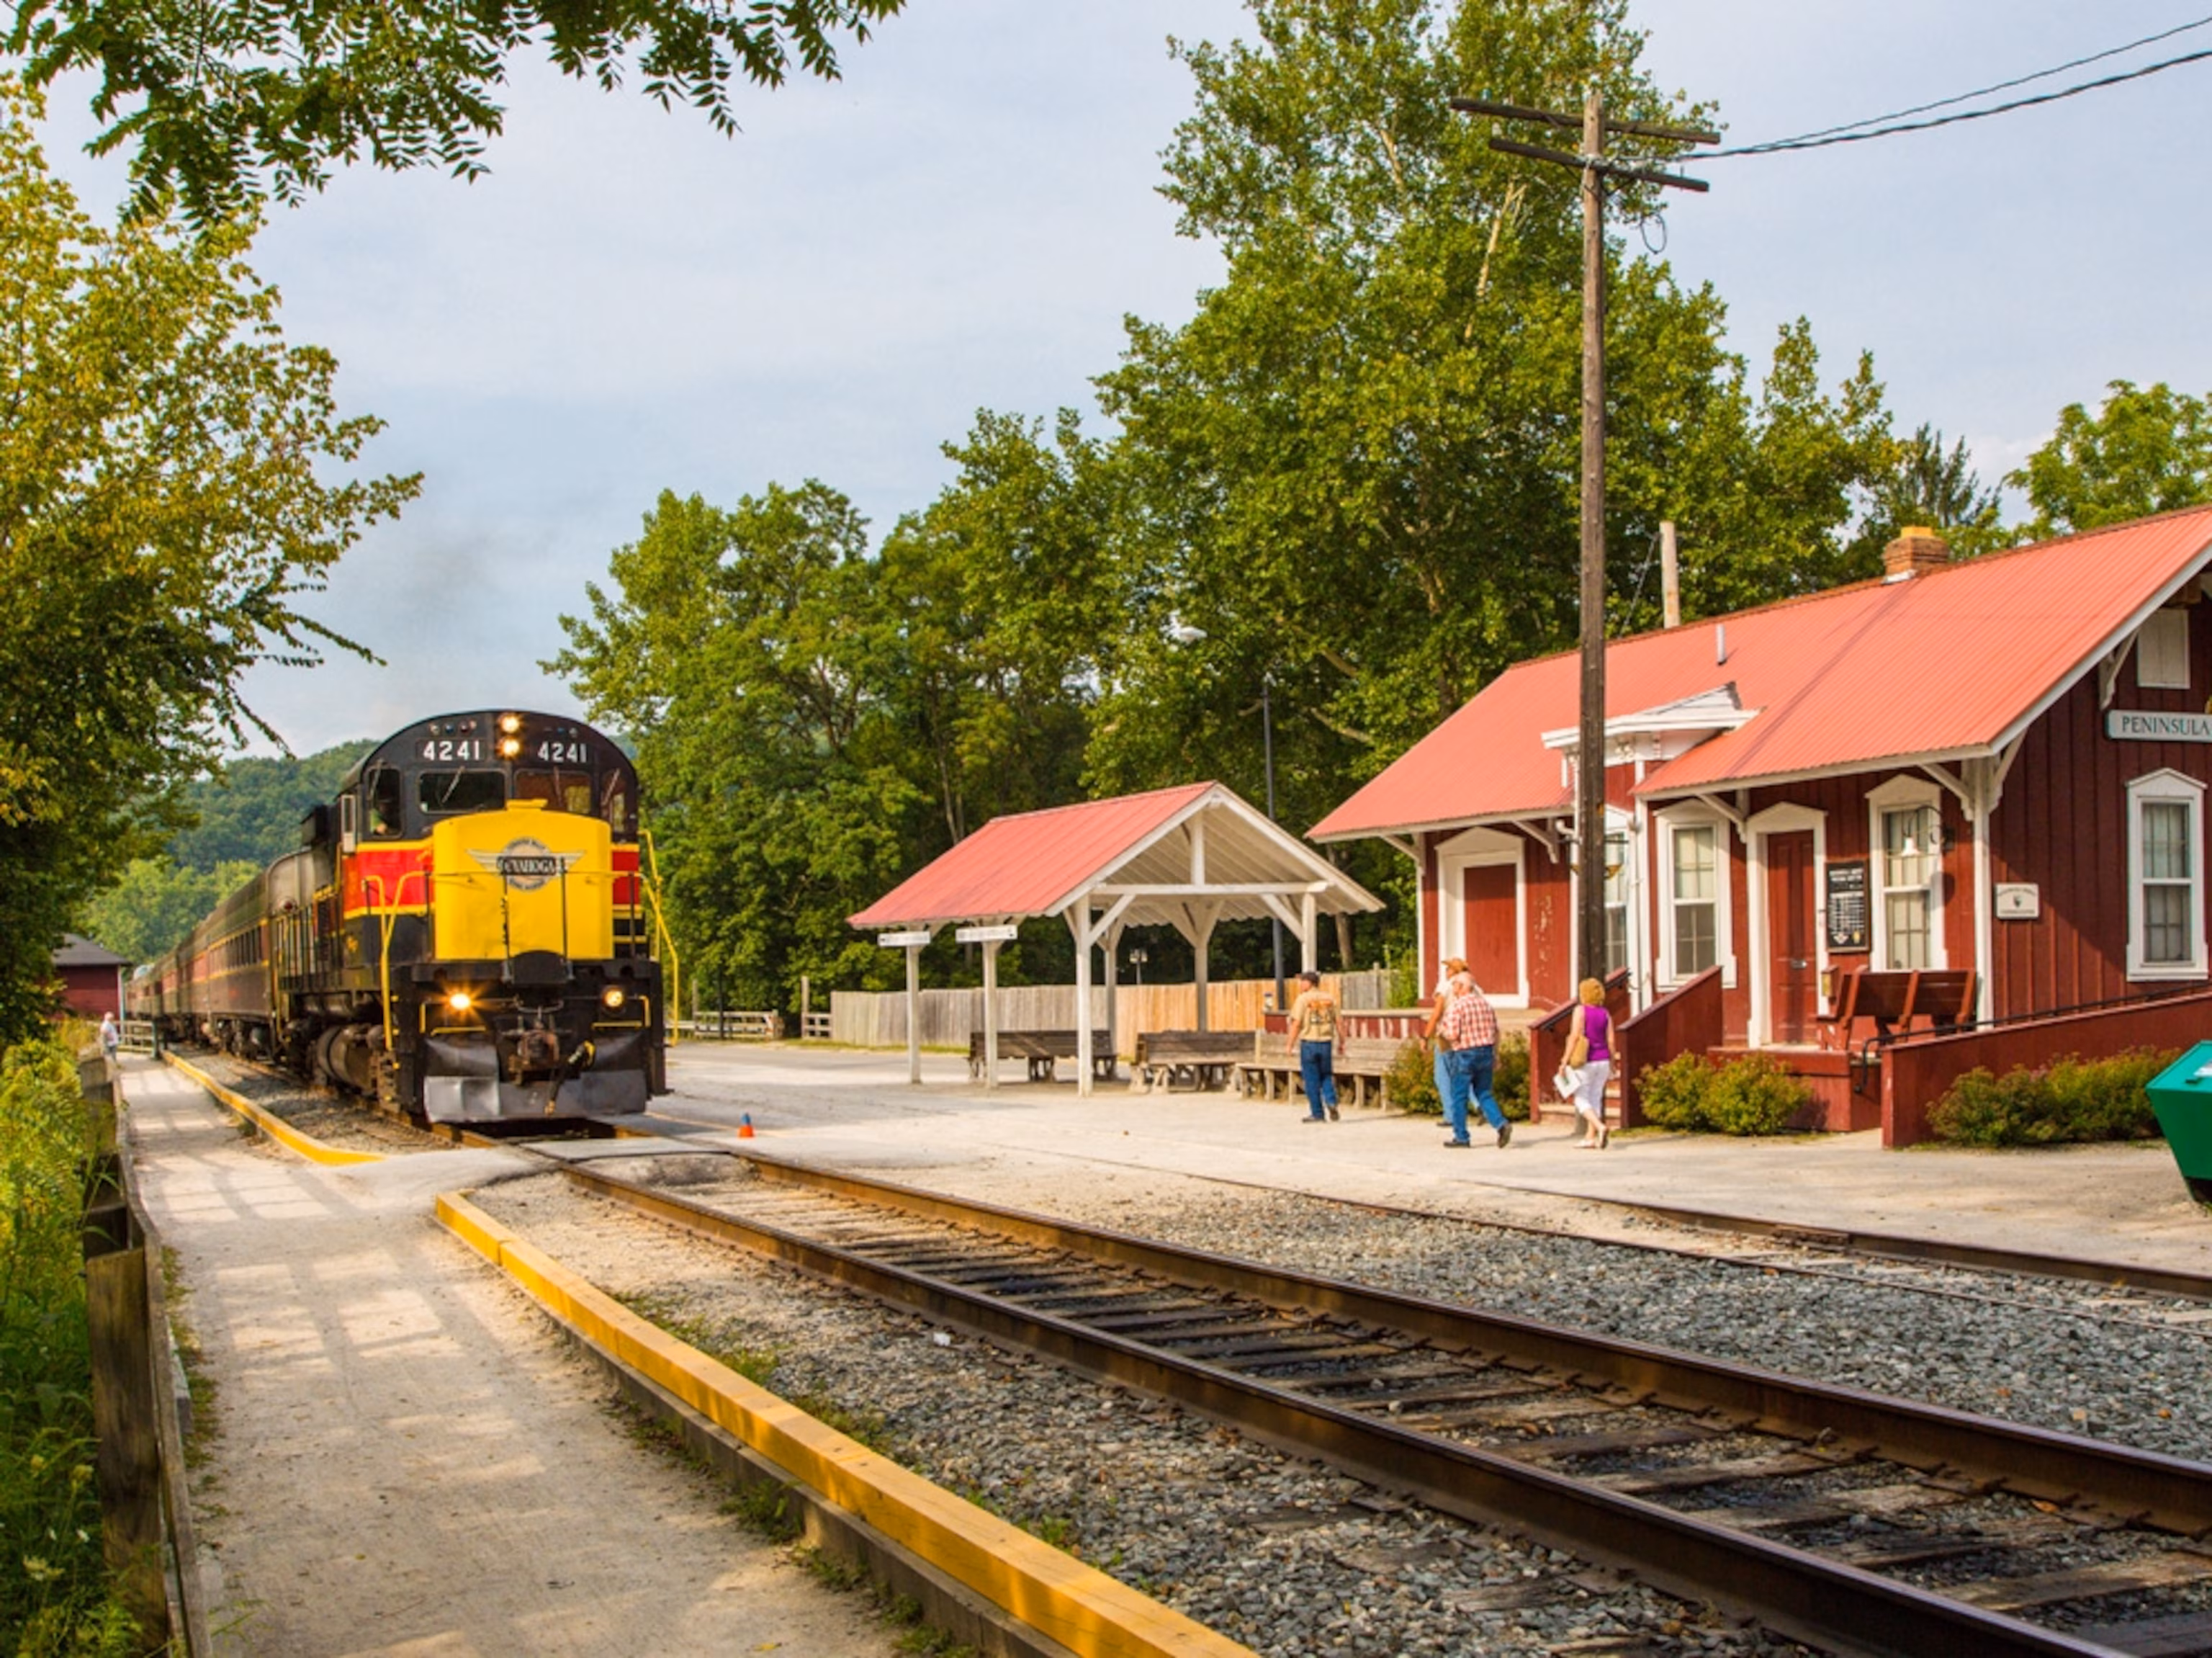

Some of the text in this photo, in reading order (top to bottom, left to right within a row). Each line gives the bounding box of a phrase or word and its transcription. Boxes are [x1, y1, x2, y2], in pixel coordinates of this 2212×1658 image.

[2121, 715, 2211, 735] PENINSULA
[423, 740, 480, 761] 4241
[537, 740, 588, 763] 4241
